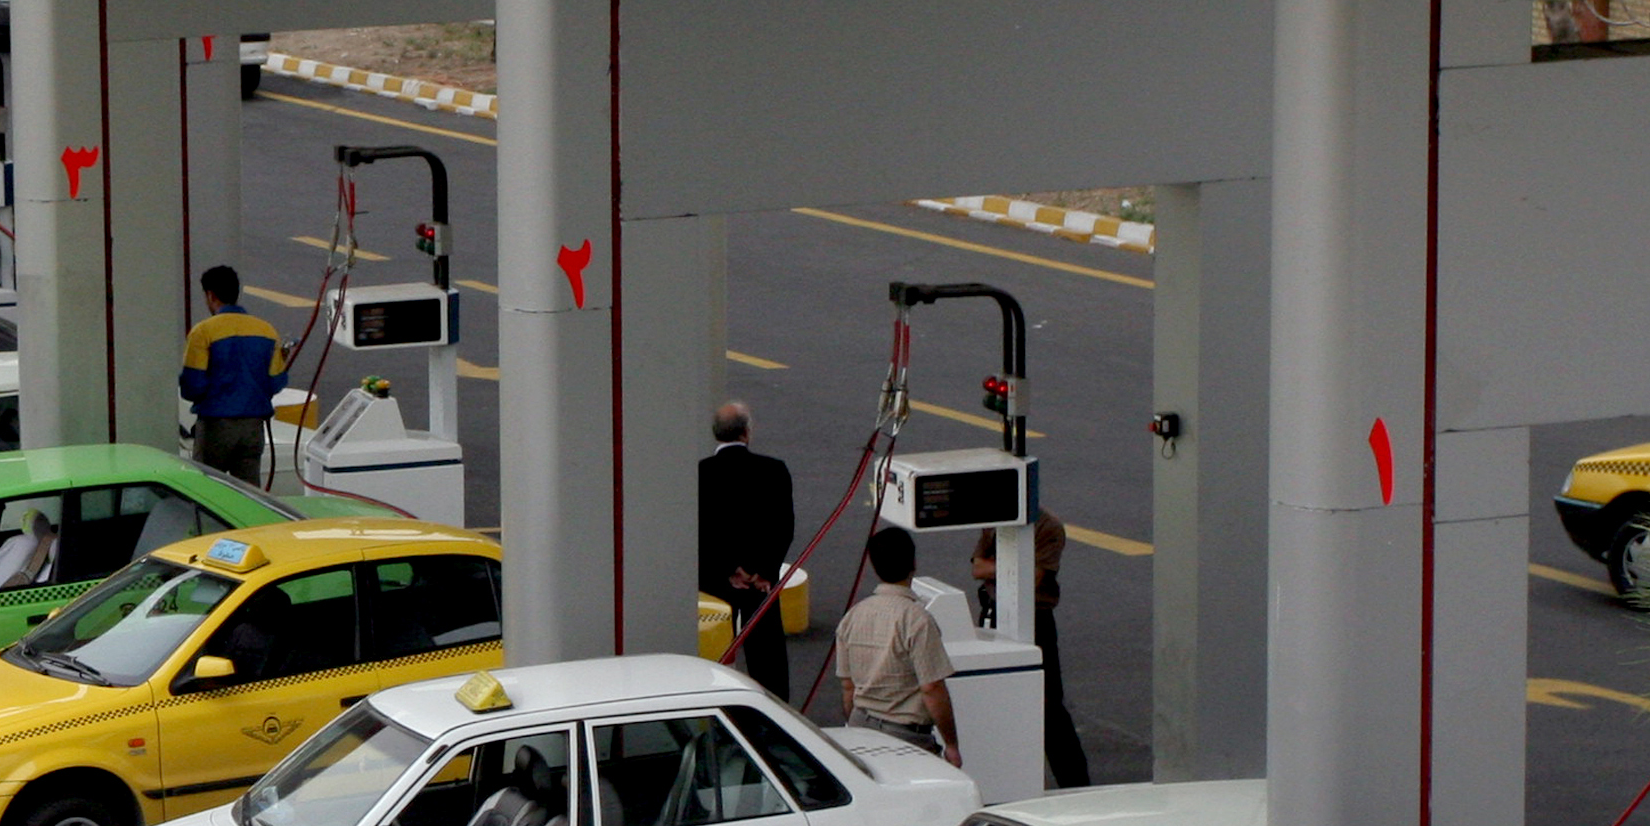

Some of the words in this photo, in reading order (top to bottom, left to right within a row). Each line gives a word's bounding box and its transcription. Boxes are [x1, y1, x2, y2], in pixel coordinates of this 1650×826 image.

[60, 146, 99, 199] ۳
[557, 239, 592, 309] ۲
[1368, 418, 1394, 505] ۱
